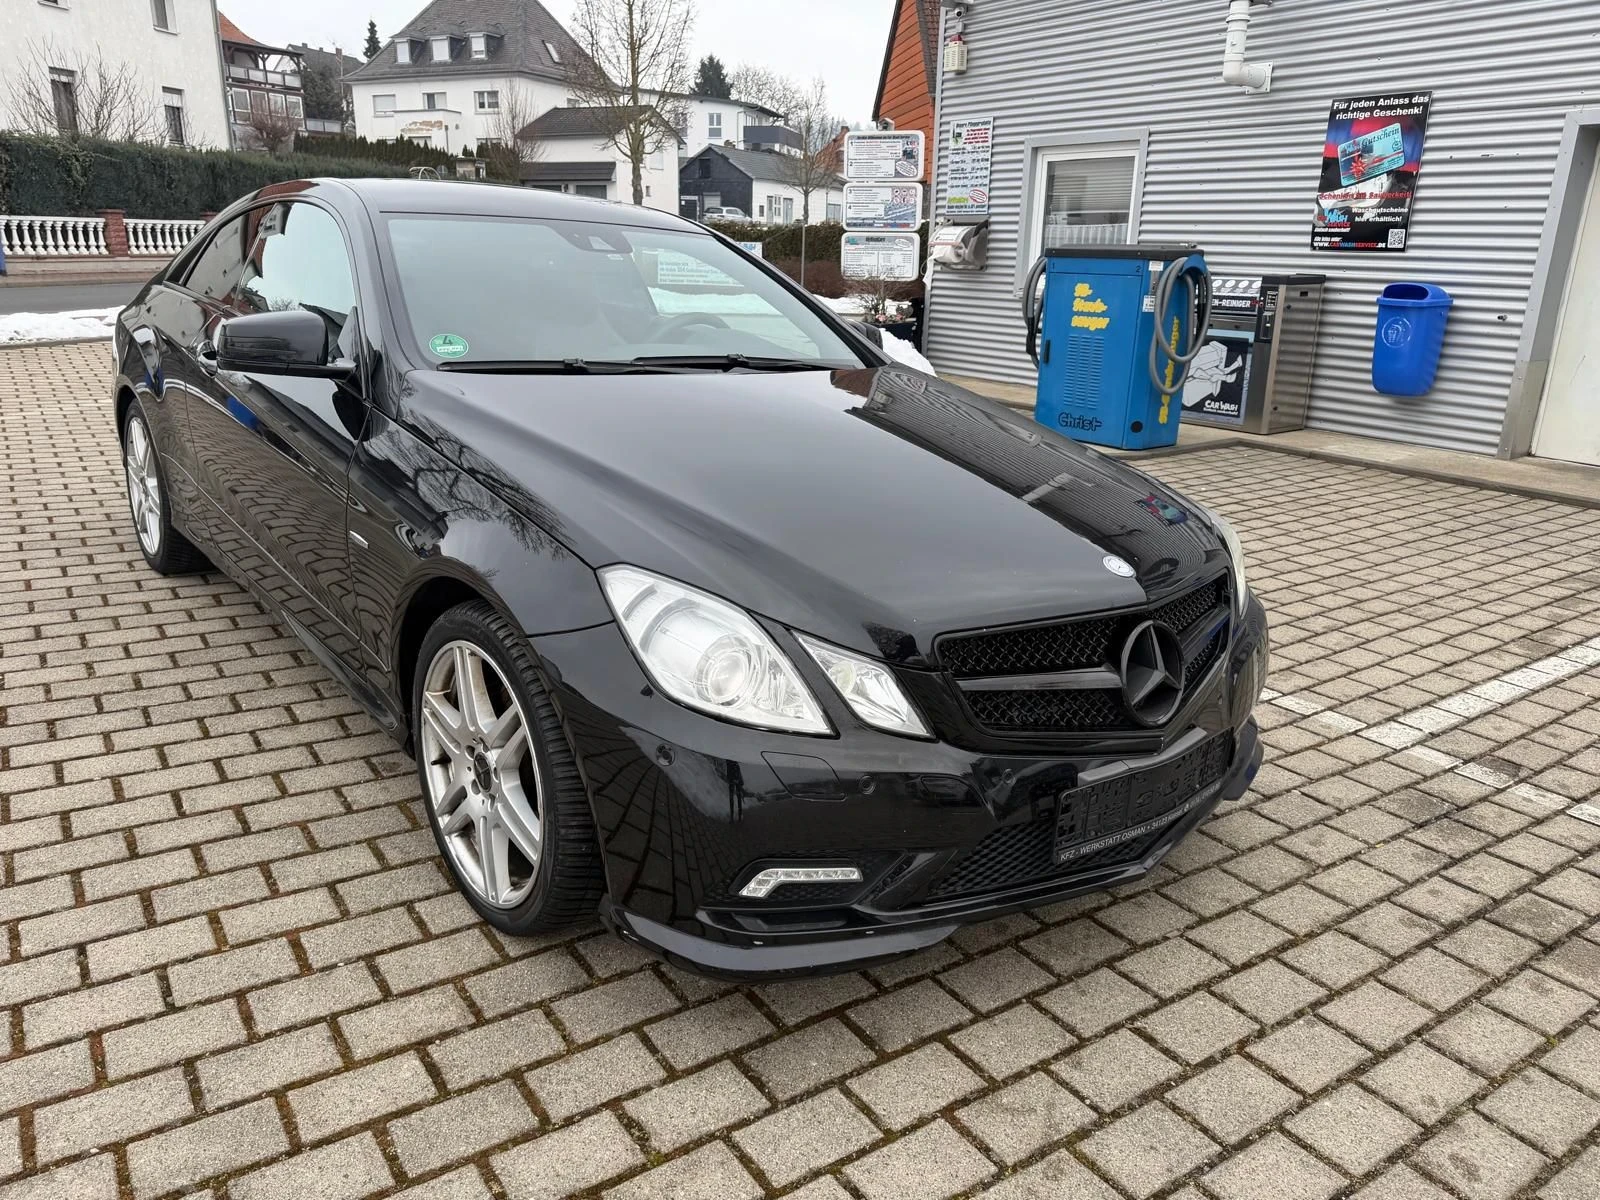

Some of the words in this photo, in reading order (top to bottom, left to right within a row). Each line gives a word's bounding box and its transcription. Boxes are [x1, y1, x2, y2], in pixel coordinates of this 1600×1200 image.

[1333, 101, 1348, 110] Für
[1349, 99, 1375, 110] jeden
[1377, 97, 1409, 107] Anlass
[1411, 95, 1429, 104] das
[1336, 110, 1370, 120] richtige
[1373, 106, 1423, 117] Geschenk!
[1361, 128, 1400, 149] Gutschein
[1204, 399, 1220, 409] CAR
[1058, 411, 1104, 432] Christ
[1060, 849, 1075, 861] KFZ
[1080, 834, 1121, 855] WERKSTATT
[1121, 825, 1146, 840] OSMAN
